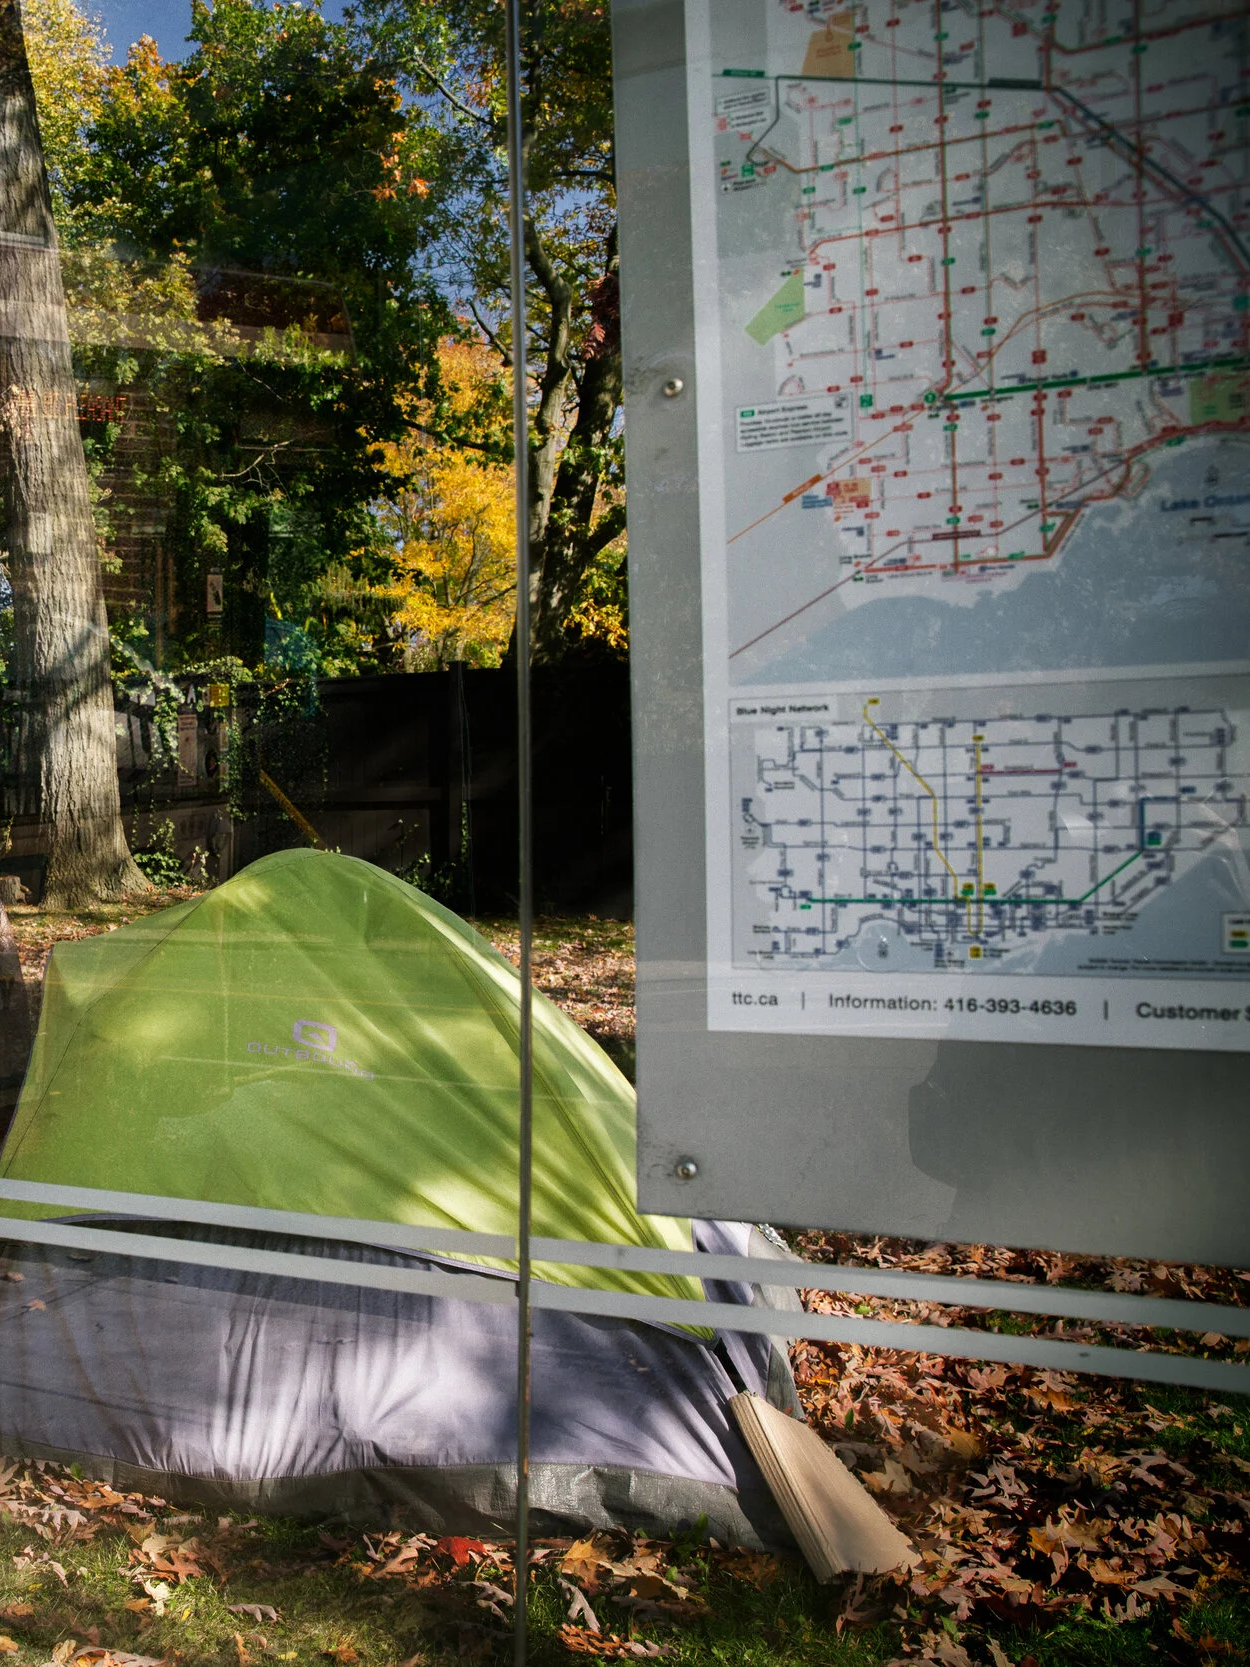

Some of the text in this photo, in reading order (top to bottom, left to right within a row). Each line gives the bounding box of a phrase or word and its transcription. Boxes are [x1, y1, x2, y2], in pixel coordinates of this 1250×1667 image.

[736, 703, 829, 716] Blue Night Network
[731, 992, 779, 1006] ttc.ca
[829, 993, 938, 1011] Information:
[944, 997, 1078, 1016] 416-393-4636
[1135, 1001, 1240, 1021] Customer
[247, 1041, 375, 1081] OUTBOUND
